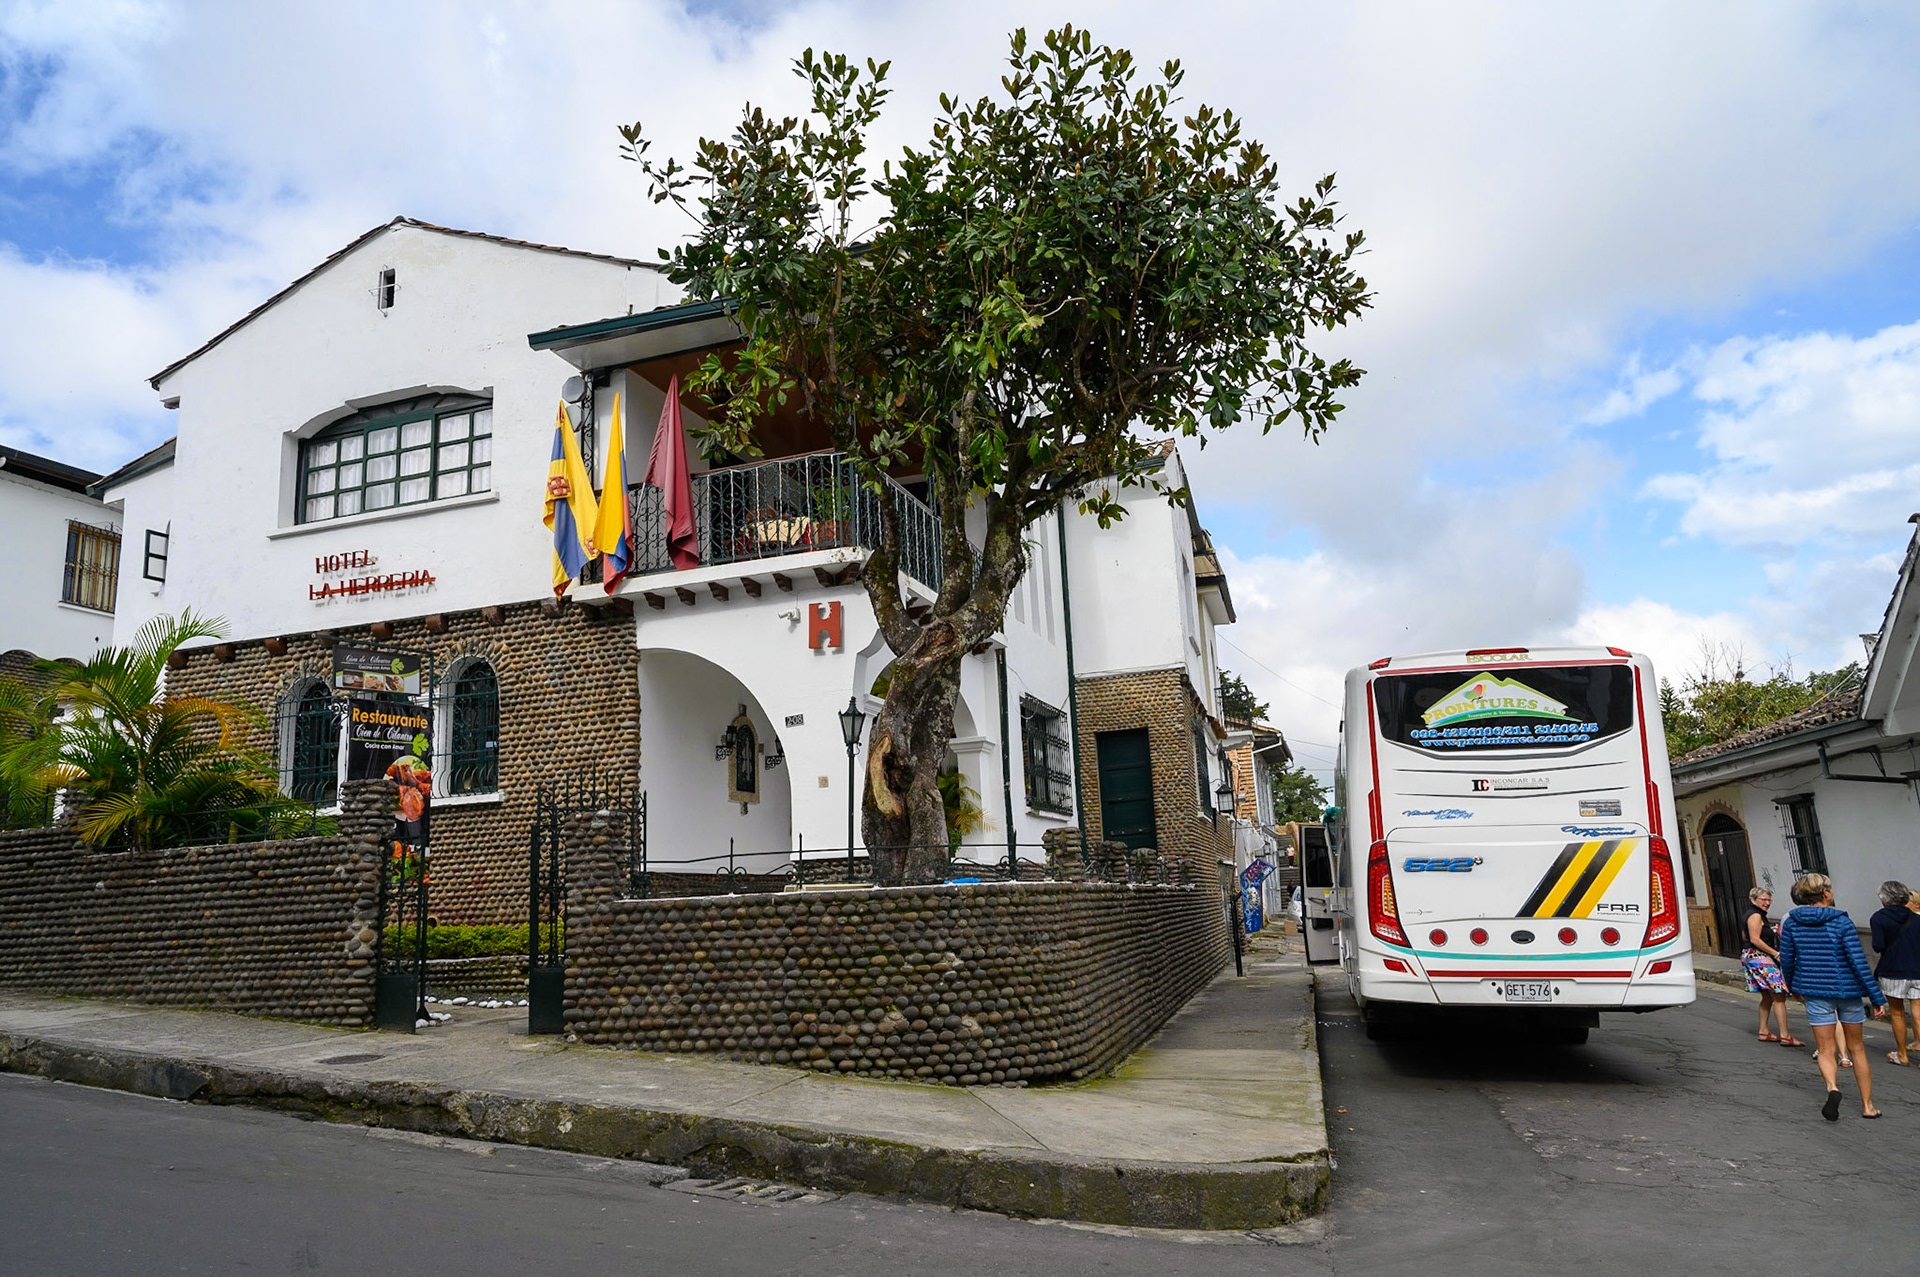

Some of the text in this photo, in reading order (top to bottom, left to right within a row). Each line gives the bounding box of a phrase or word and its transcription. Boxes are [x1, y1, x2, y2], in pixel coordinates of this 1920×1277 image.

[315, 549, 377, 574] HOTEL
[309, 569, 433, 600] LA HERRERIA
[1467, 653, 1532, 663] ESCOLAR
[352, 707, 429, 729] Restaurante
[1421, 697, 1538, 724] PROINTURES
[355, 724, 414, 741] Cien de Cilantro
[1419, 733, 1590, 748] www.prointures.com.co
[1597, 903, 1639, 912] FRR
